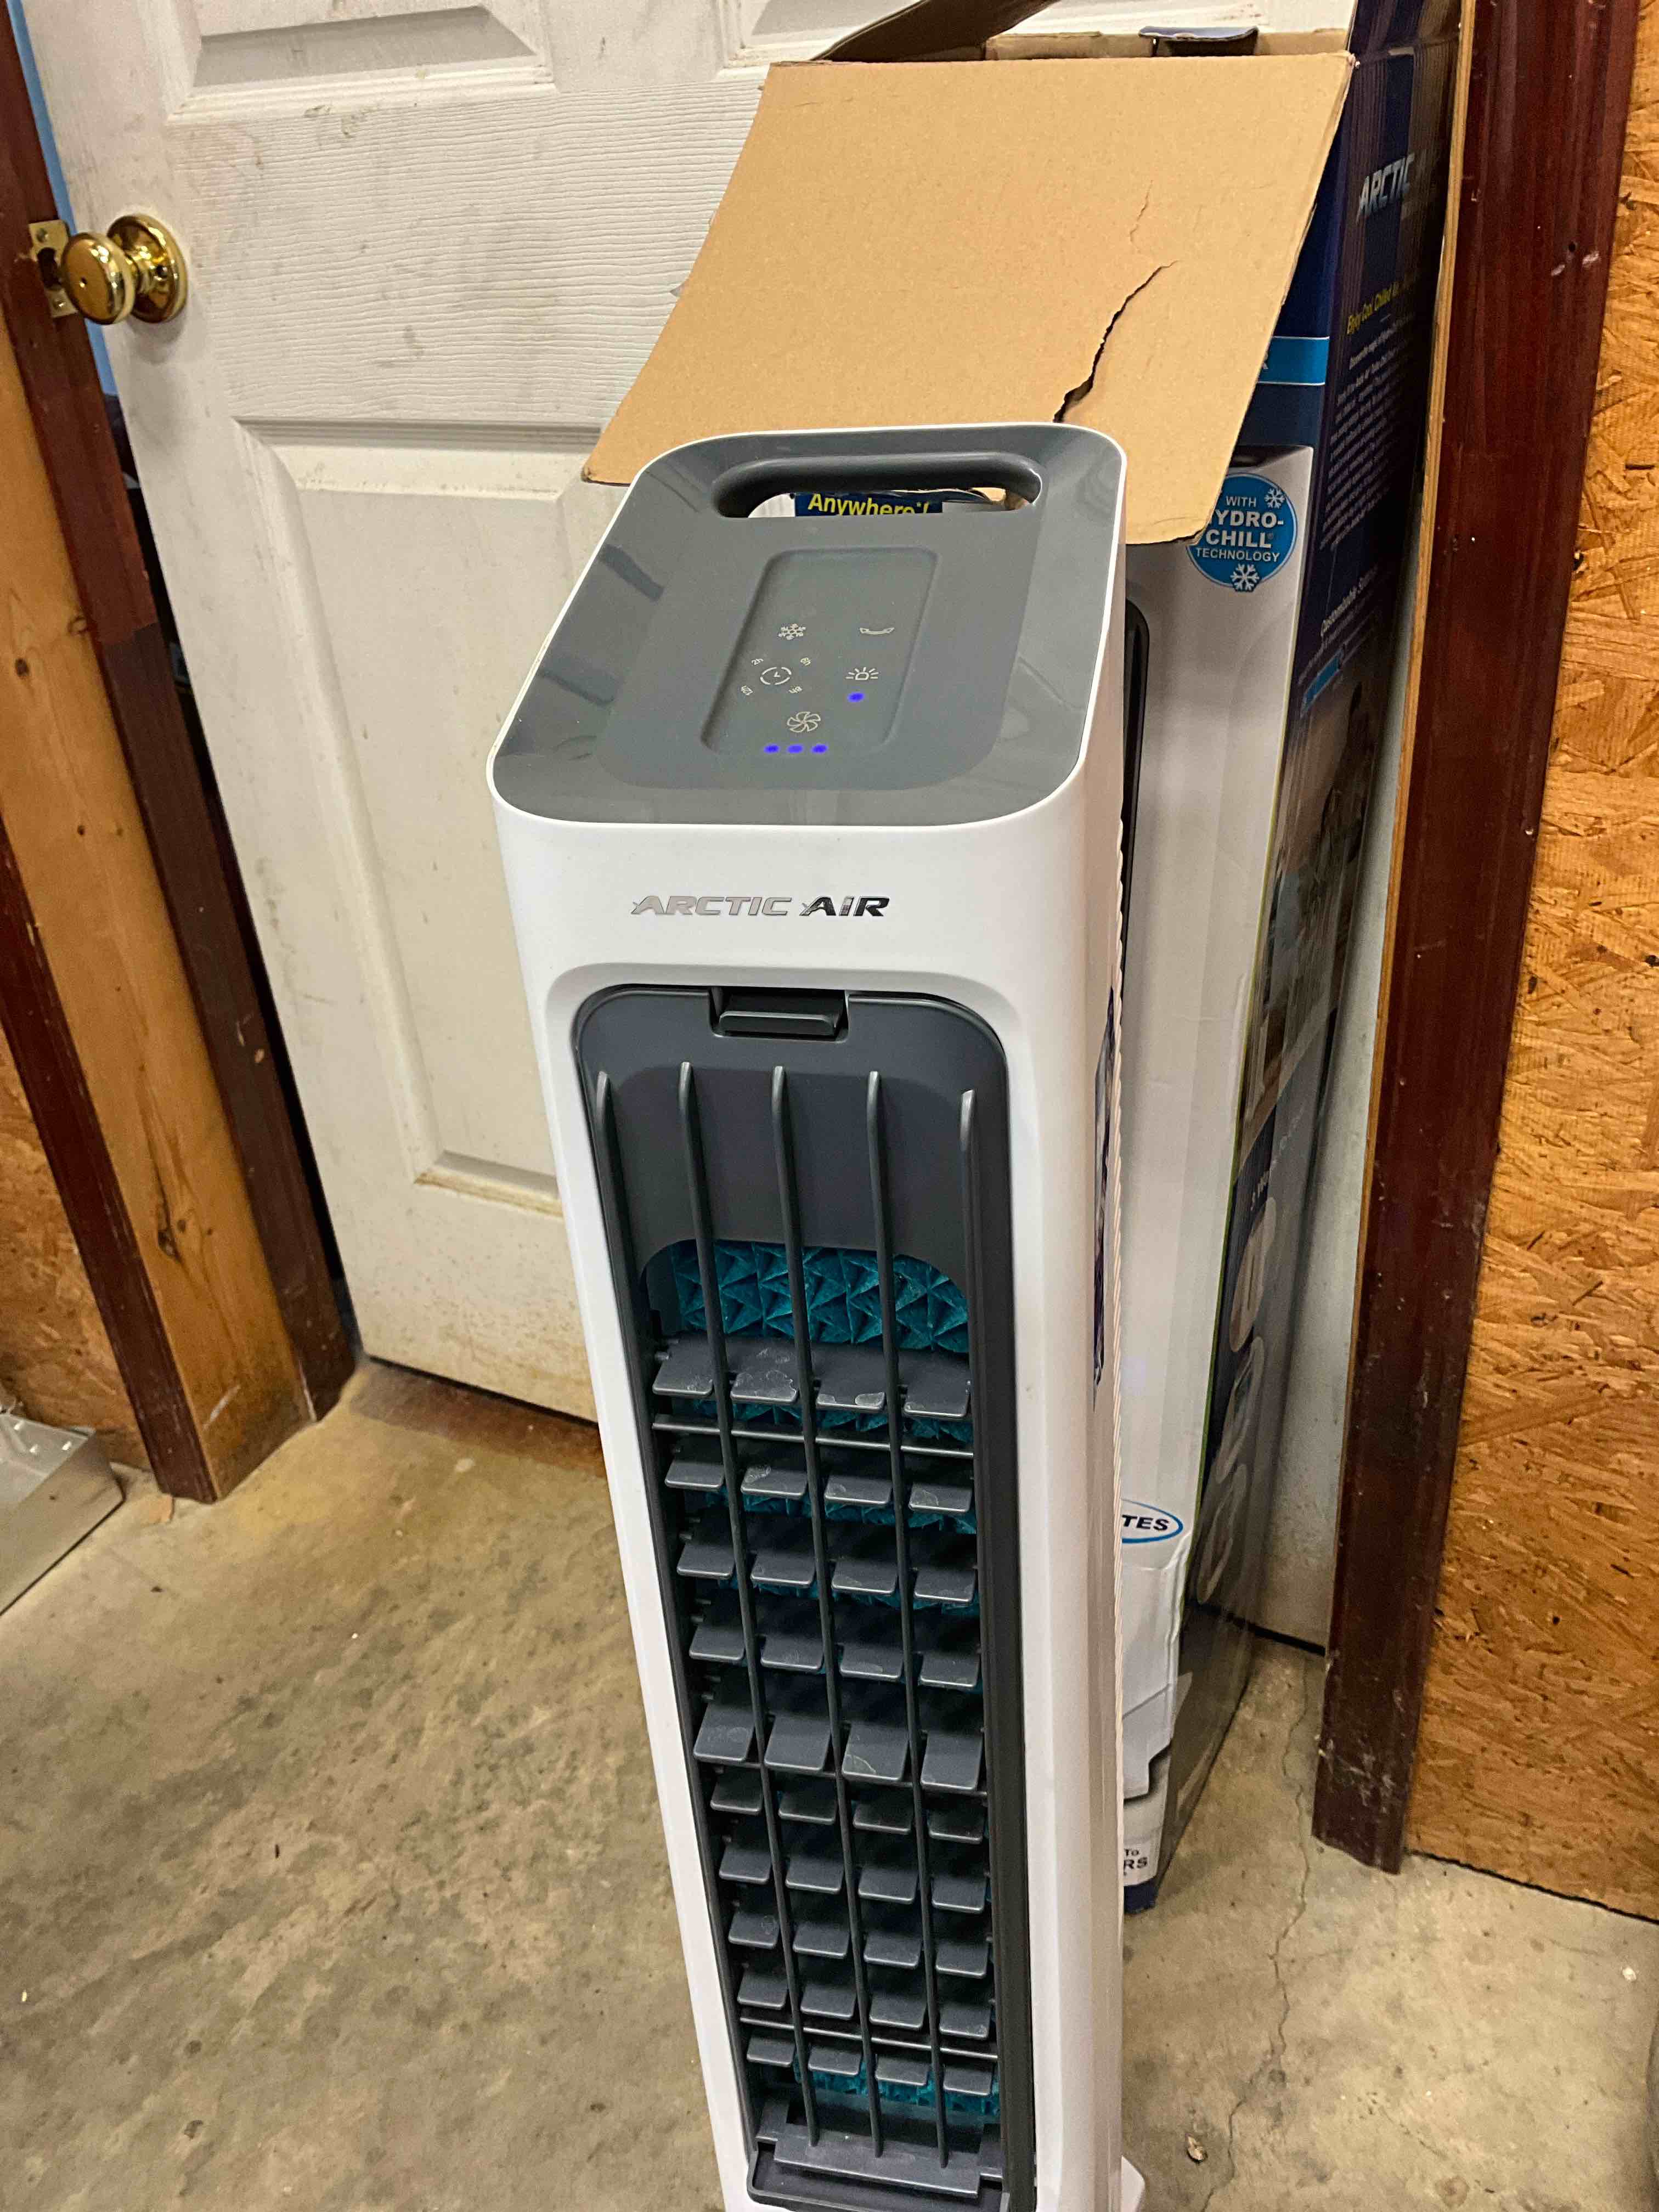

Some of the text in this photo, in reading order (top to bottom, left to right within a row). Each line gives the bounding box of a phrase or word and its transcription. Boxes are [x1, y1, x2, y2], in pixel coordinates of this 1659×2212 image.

[1356, 153, 1415, 224] ARCTIC
[1226, 496, 1256, 507] WITH
[1209, 509, 1284, 528] YDRO-
[1197, 548, 1279, 562] TECHNOLOGY
[631, 895, 890, 917] ARCTIC AIR
